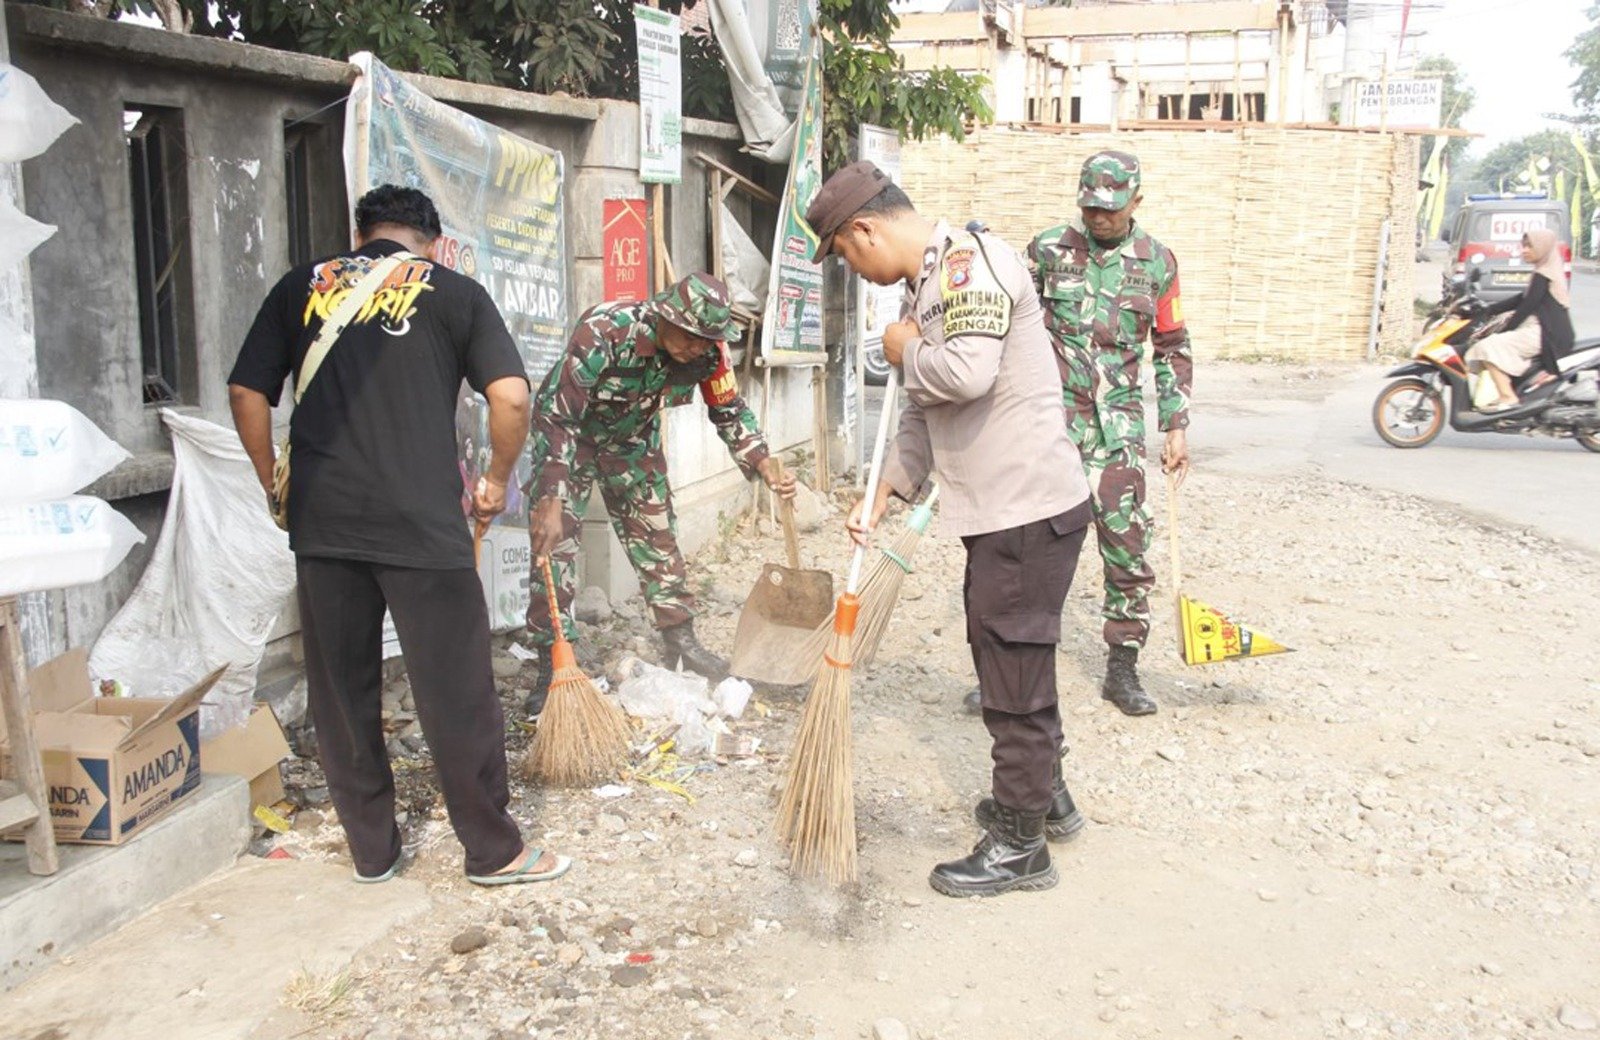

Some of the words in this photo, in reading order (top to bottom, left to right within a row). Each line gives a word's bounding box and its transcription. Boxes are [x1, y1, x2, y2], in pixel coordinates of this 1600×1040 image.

[610, 237, 641, 266] AGE
[616, 267, 635, 282] PRO
[504, 279, 561, 320] AKBAR
[945, 319, 1005, 335] SRENGAT
[122, 742, 186, 806] AMANDA
[50, 786, 90, 805] NDA
